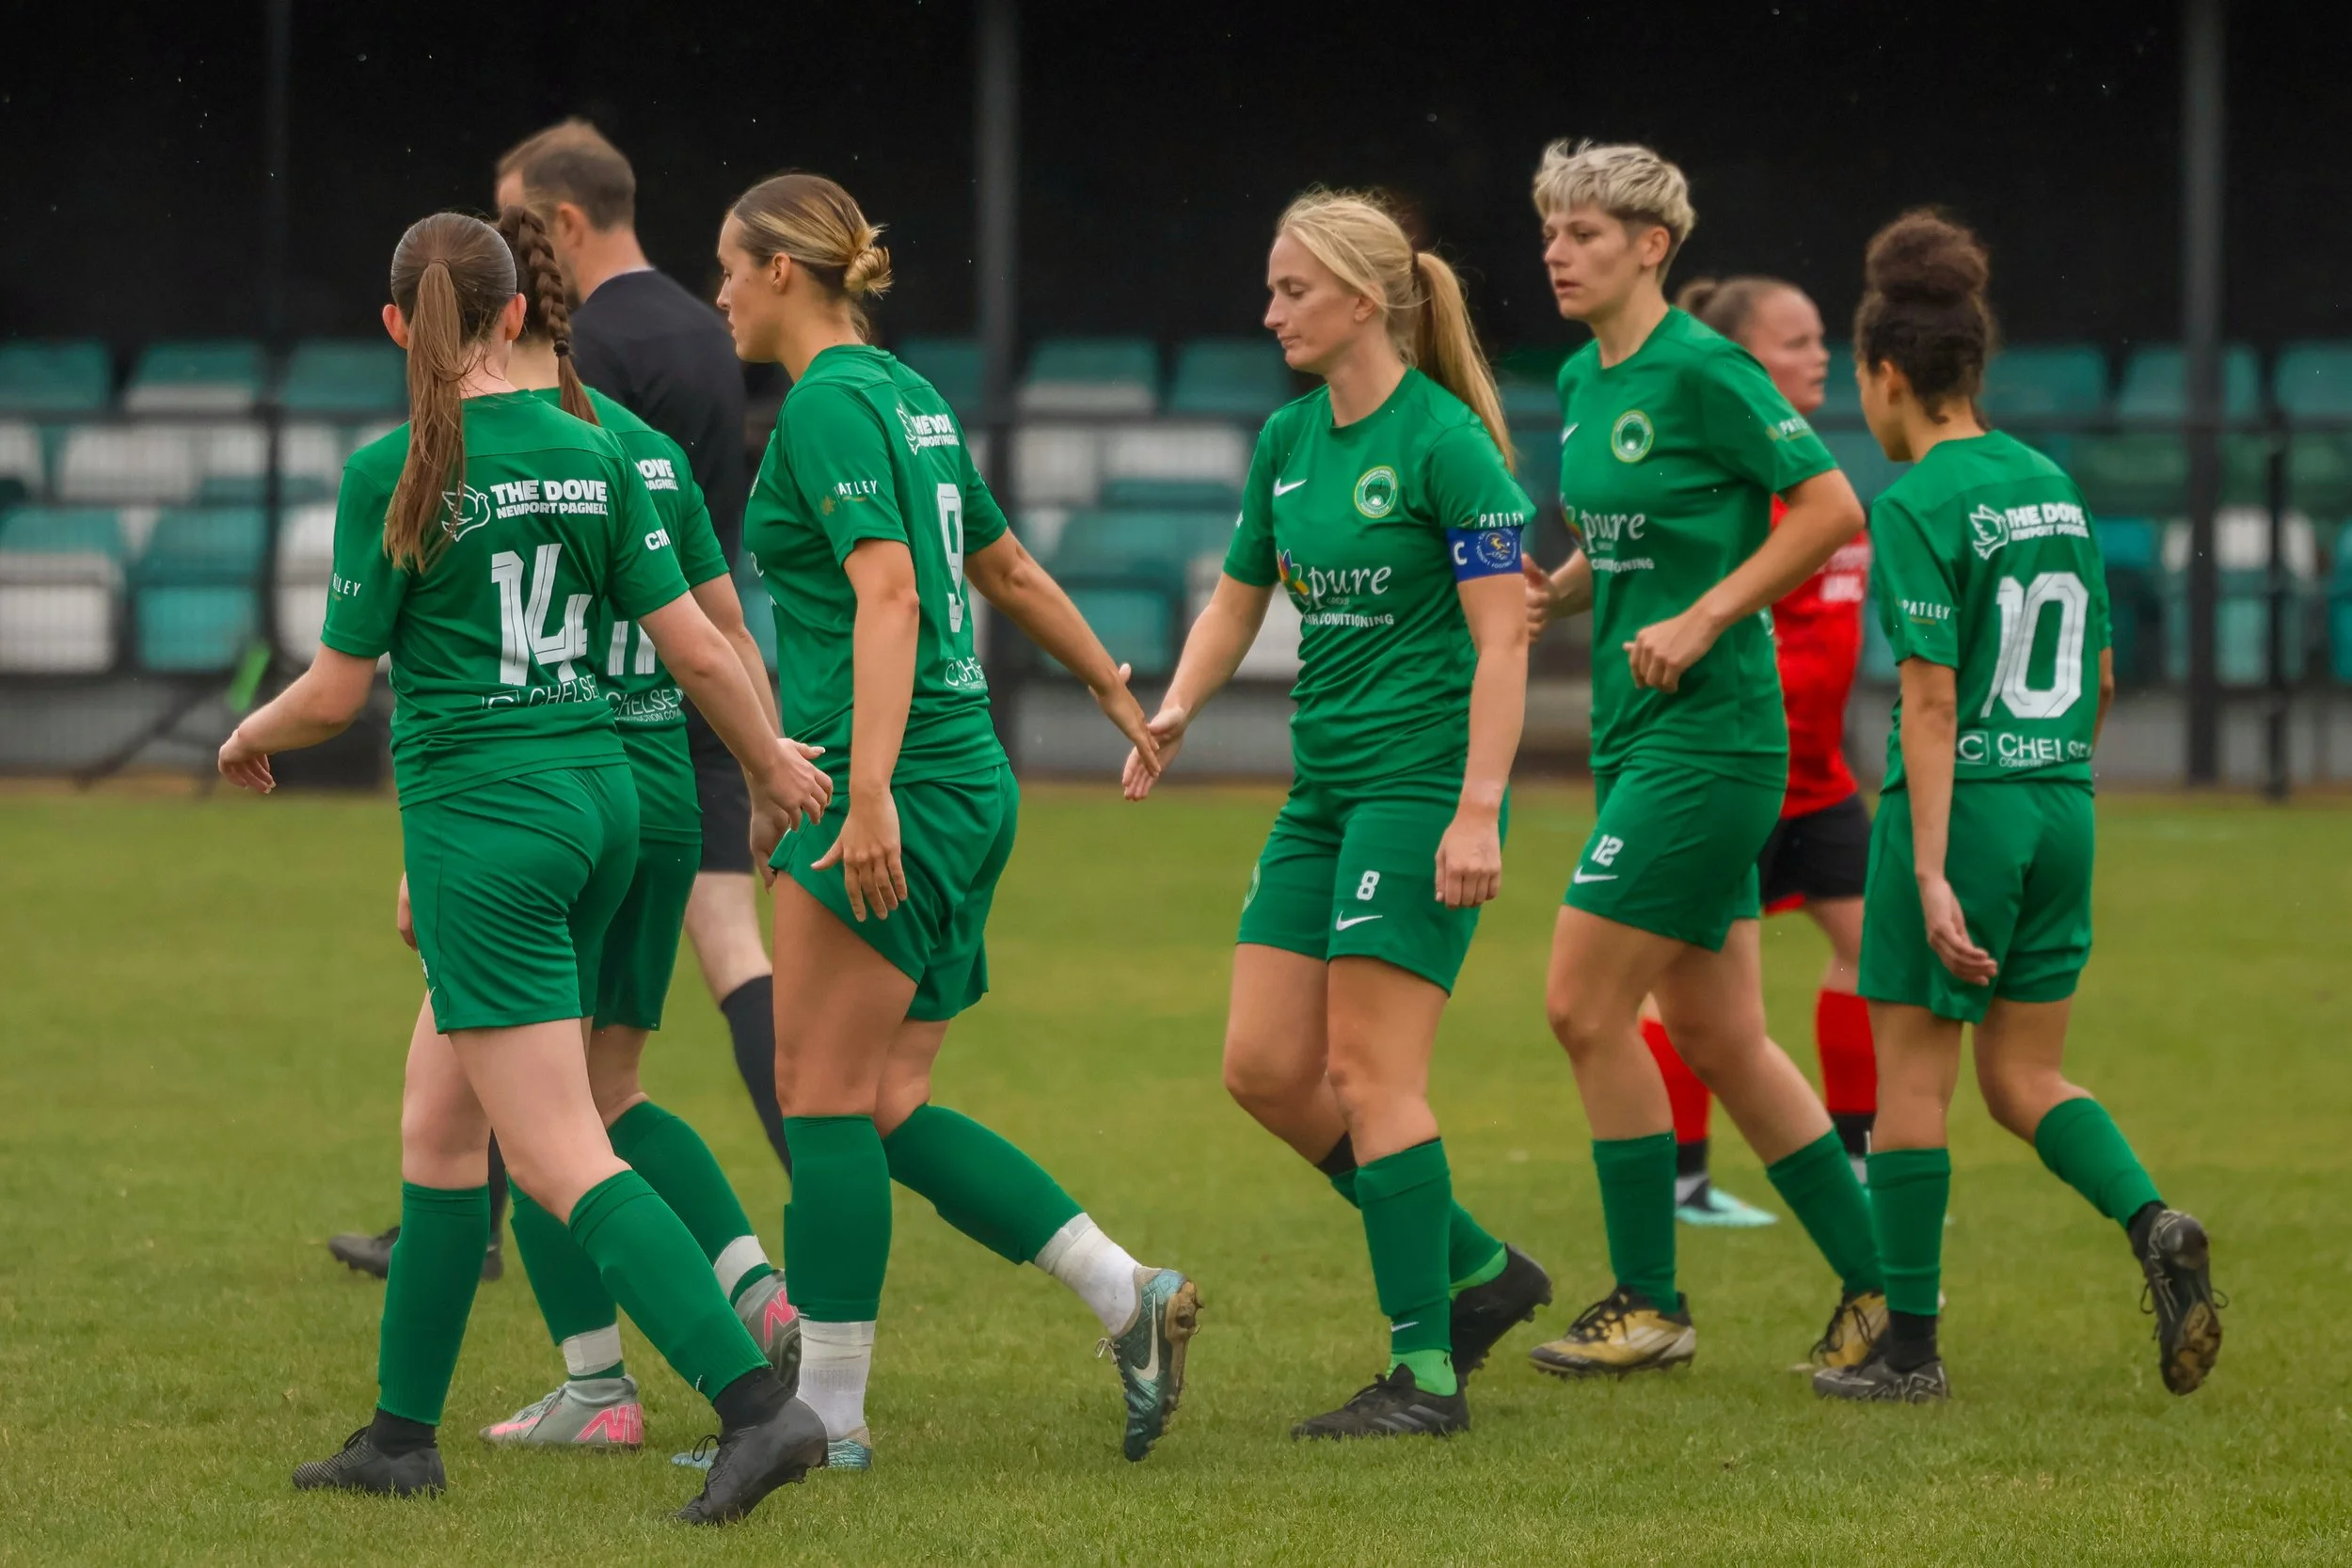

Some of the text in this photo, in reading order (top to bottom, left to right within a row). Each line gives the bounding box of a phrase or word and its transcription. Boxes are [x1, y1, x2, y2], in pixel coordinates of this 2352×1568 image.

[635, 458, 675, 479] OVE
[490, 479, 608, 505] THE DOVE
[644, 478, 679, 491] AGNELL
[834, 480, 877, 499] ATLEY
[496, 501, 558, 519] NEWPORT
[2005, 504, 2042, 529] THE
[1581, 509, 1646, 554] pure
[936, 483, 964, 633] 9
[1454, 541, 1468, 566] C
[1308, 566, 1392, 610] pure
[491, 543, 593, 687] 14
[1900, 599, 1950, 621] PATLEY
[1979, 571, 2090, 719] 10
[528, 673, 599, 707] CHELSE
[1591, 834, 1624, 866] 12
[1356, 870, 1381, 901] 8
